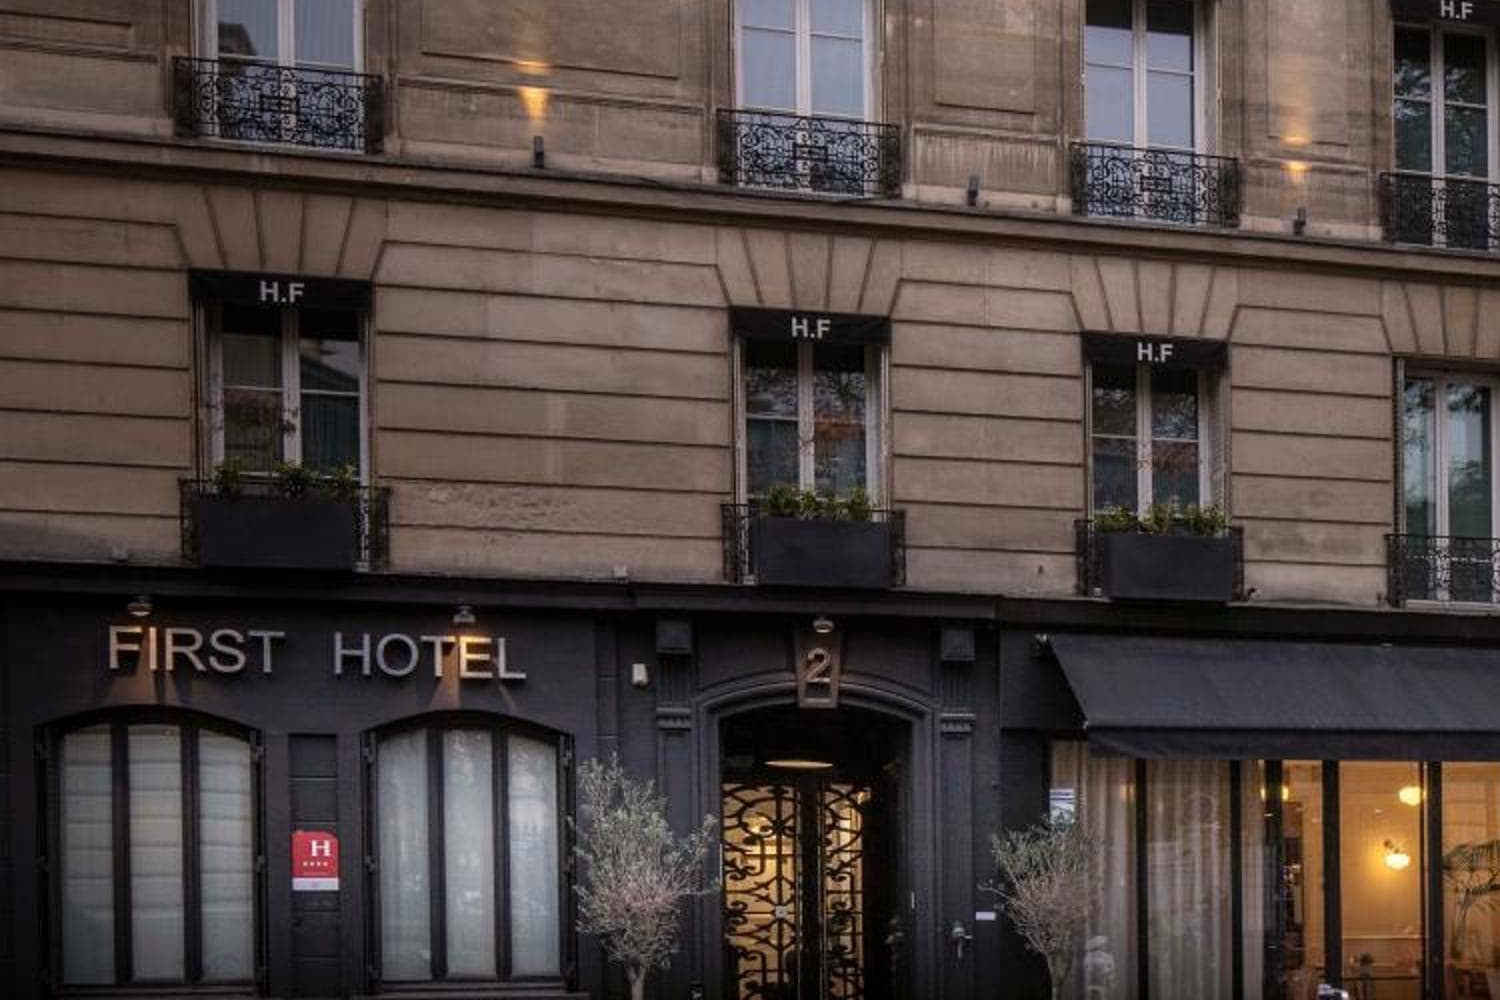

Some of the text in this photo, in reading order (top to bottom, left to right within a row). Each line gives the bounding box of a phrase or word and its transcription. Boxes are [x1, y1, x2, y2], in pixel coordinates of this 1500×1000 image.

[1441, 0, 1472, 19] H.F
[261, 281, 304, 302] H.F
[792, 317, 830, 338] H.F
[1138, 342, 1173, 362] H.F
[109, 626, 527, 679] FIRST HOTEL
[807, 648, 831, 682] 2
[312, 840, 330, 856] H
